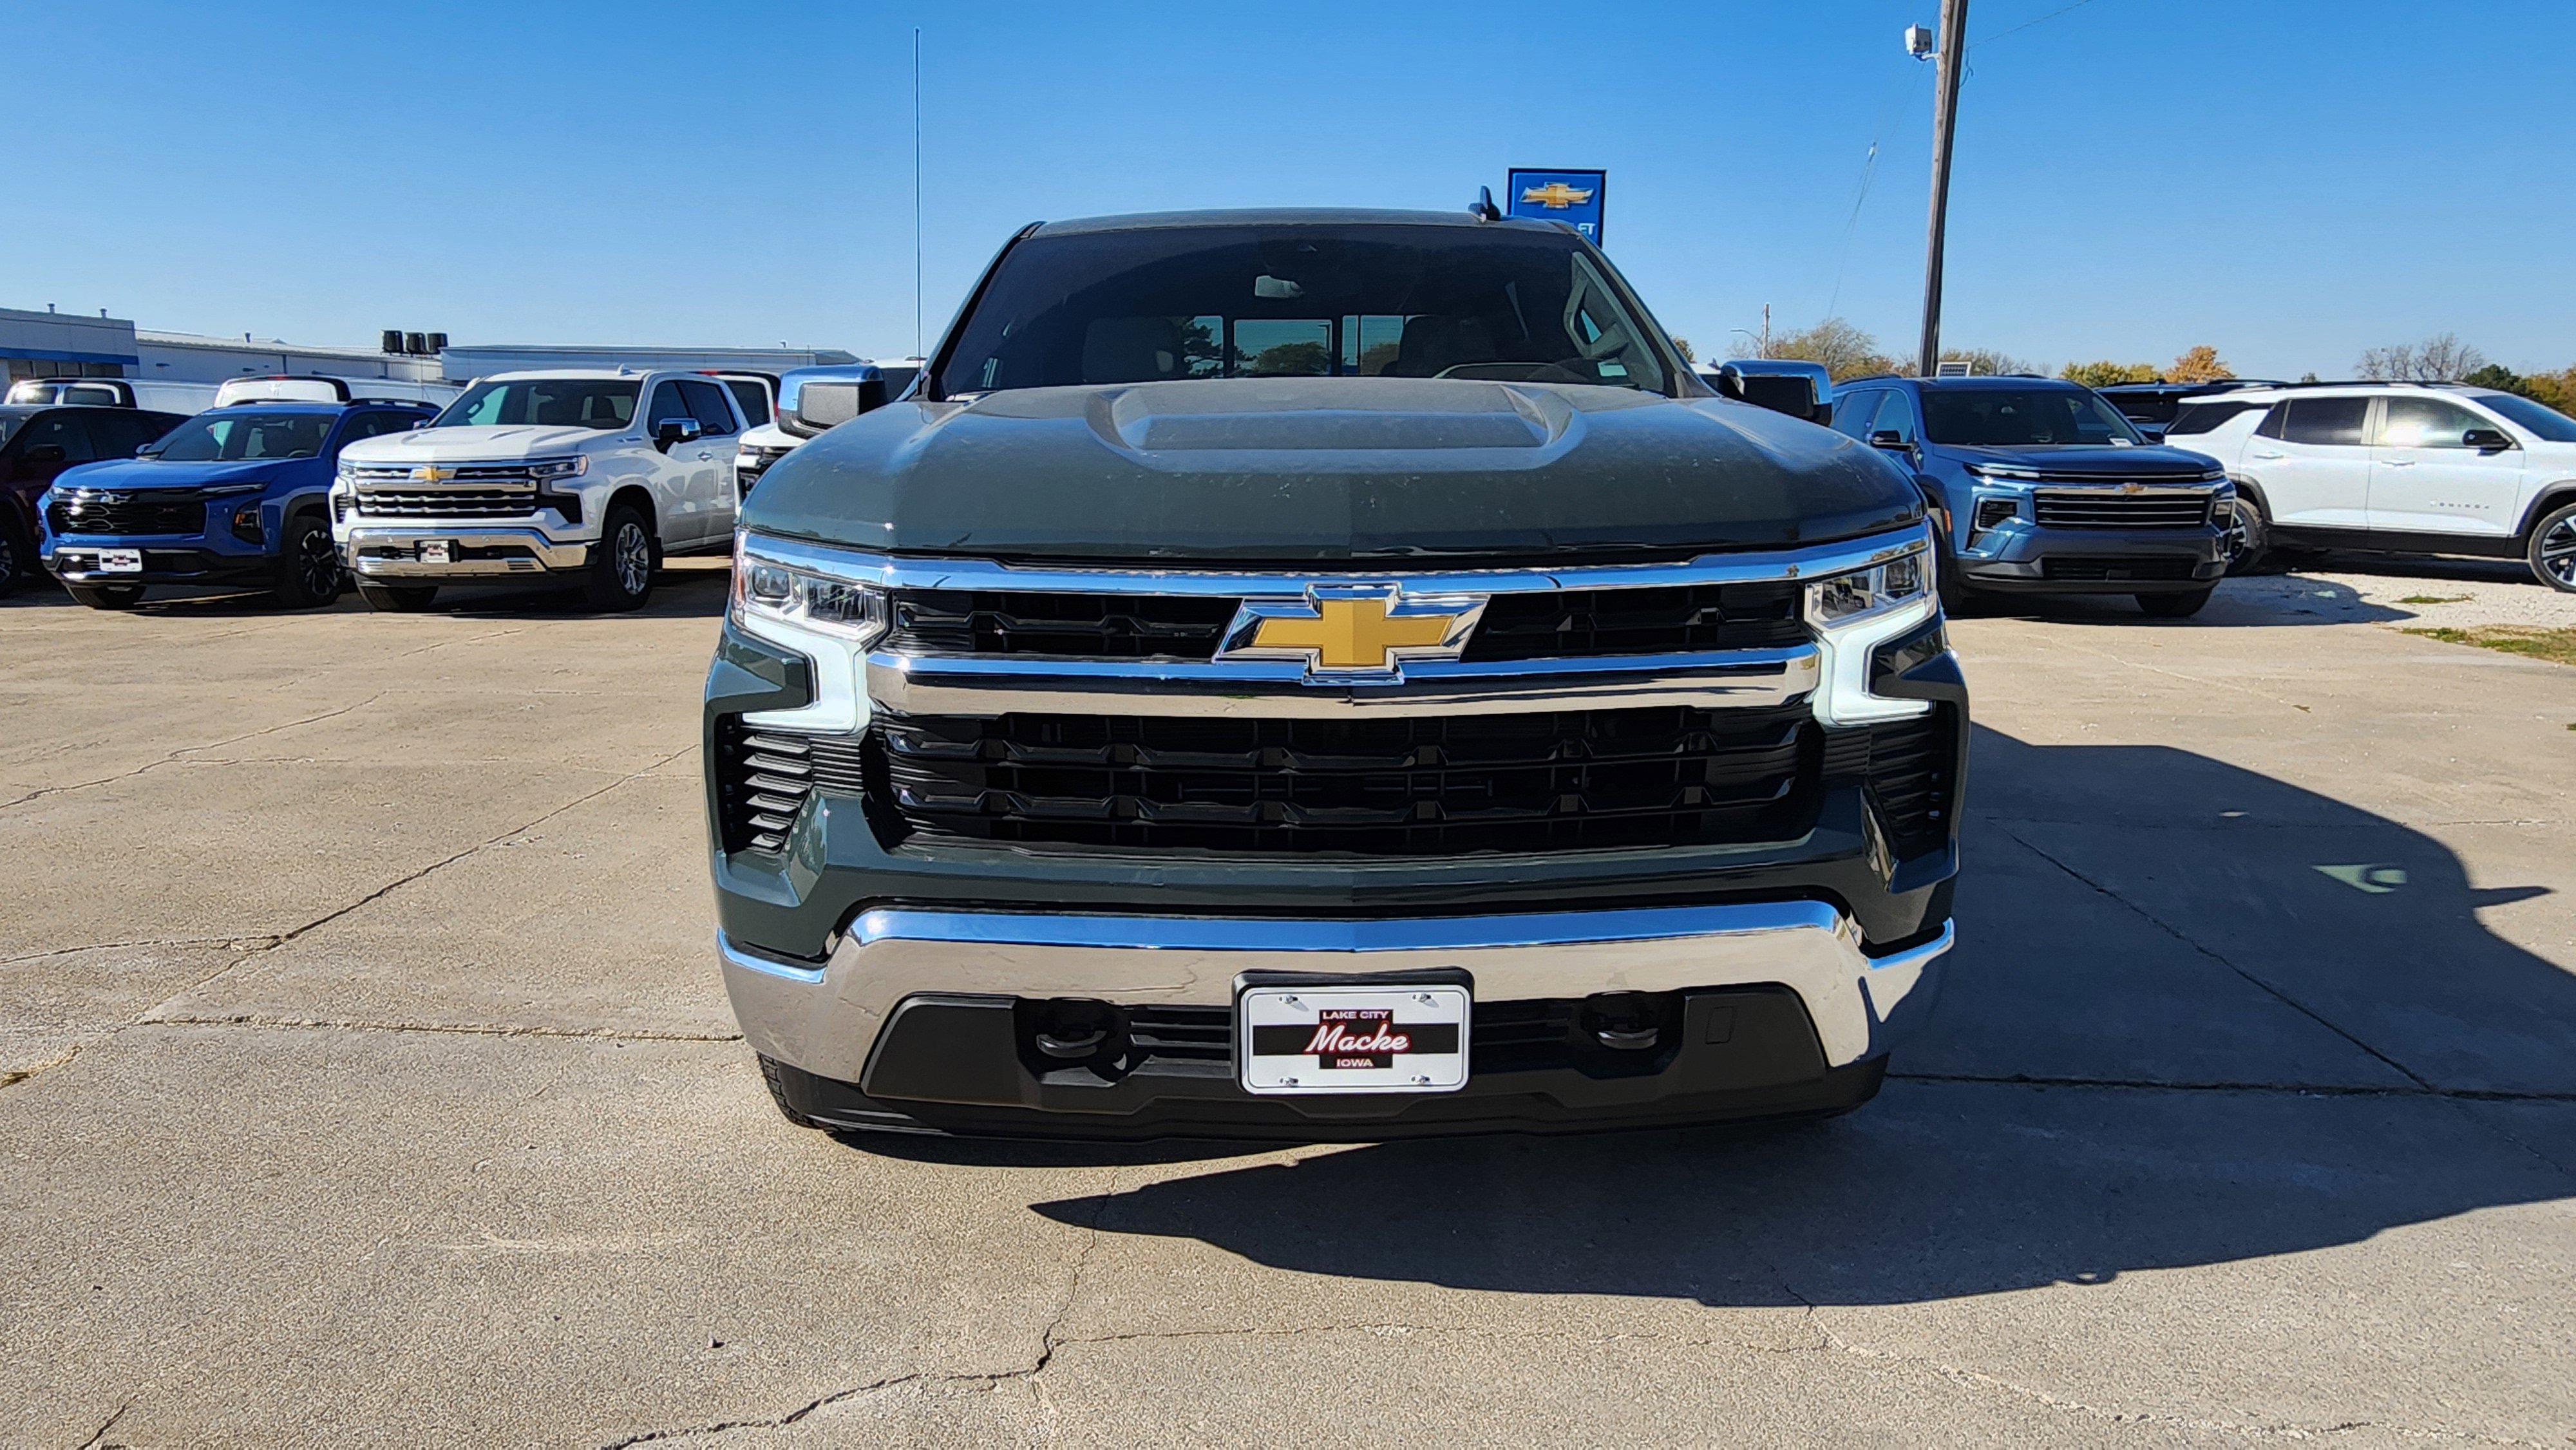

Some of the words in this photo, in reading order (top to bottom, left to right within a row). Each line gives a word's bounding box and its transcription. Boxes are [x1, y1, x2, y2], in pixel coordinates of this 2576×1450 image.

[1322, 1011, 1357, 1019] LAKE
[1359, 1011, 1388, 1019] CITY
[1305, 1022, 1409, 1053] Macke
[1336, 1059, 1374, 1067] IOWA
